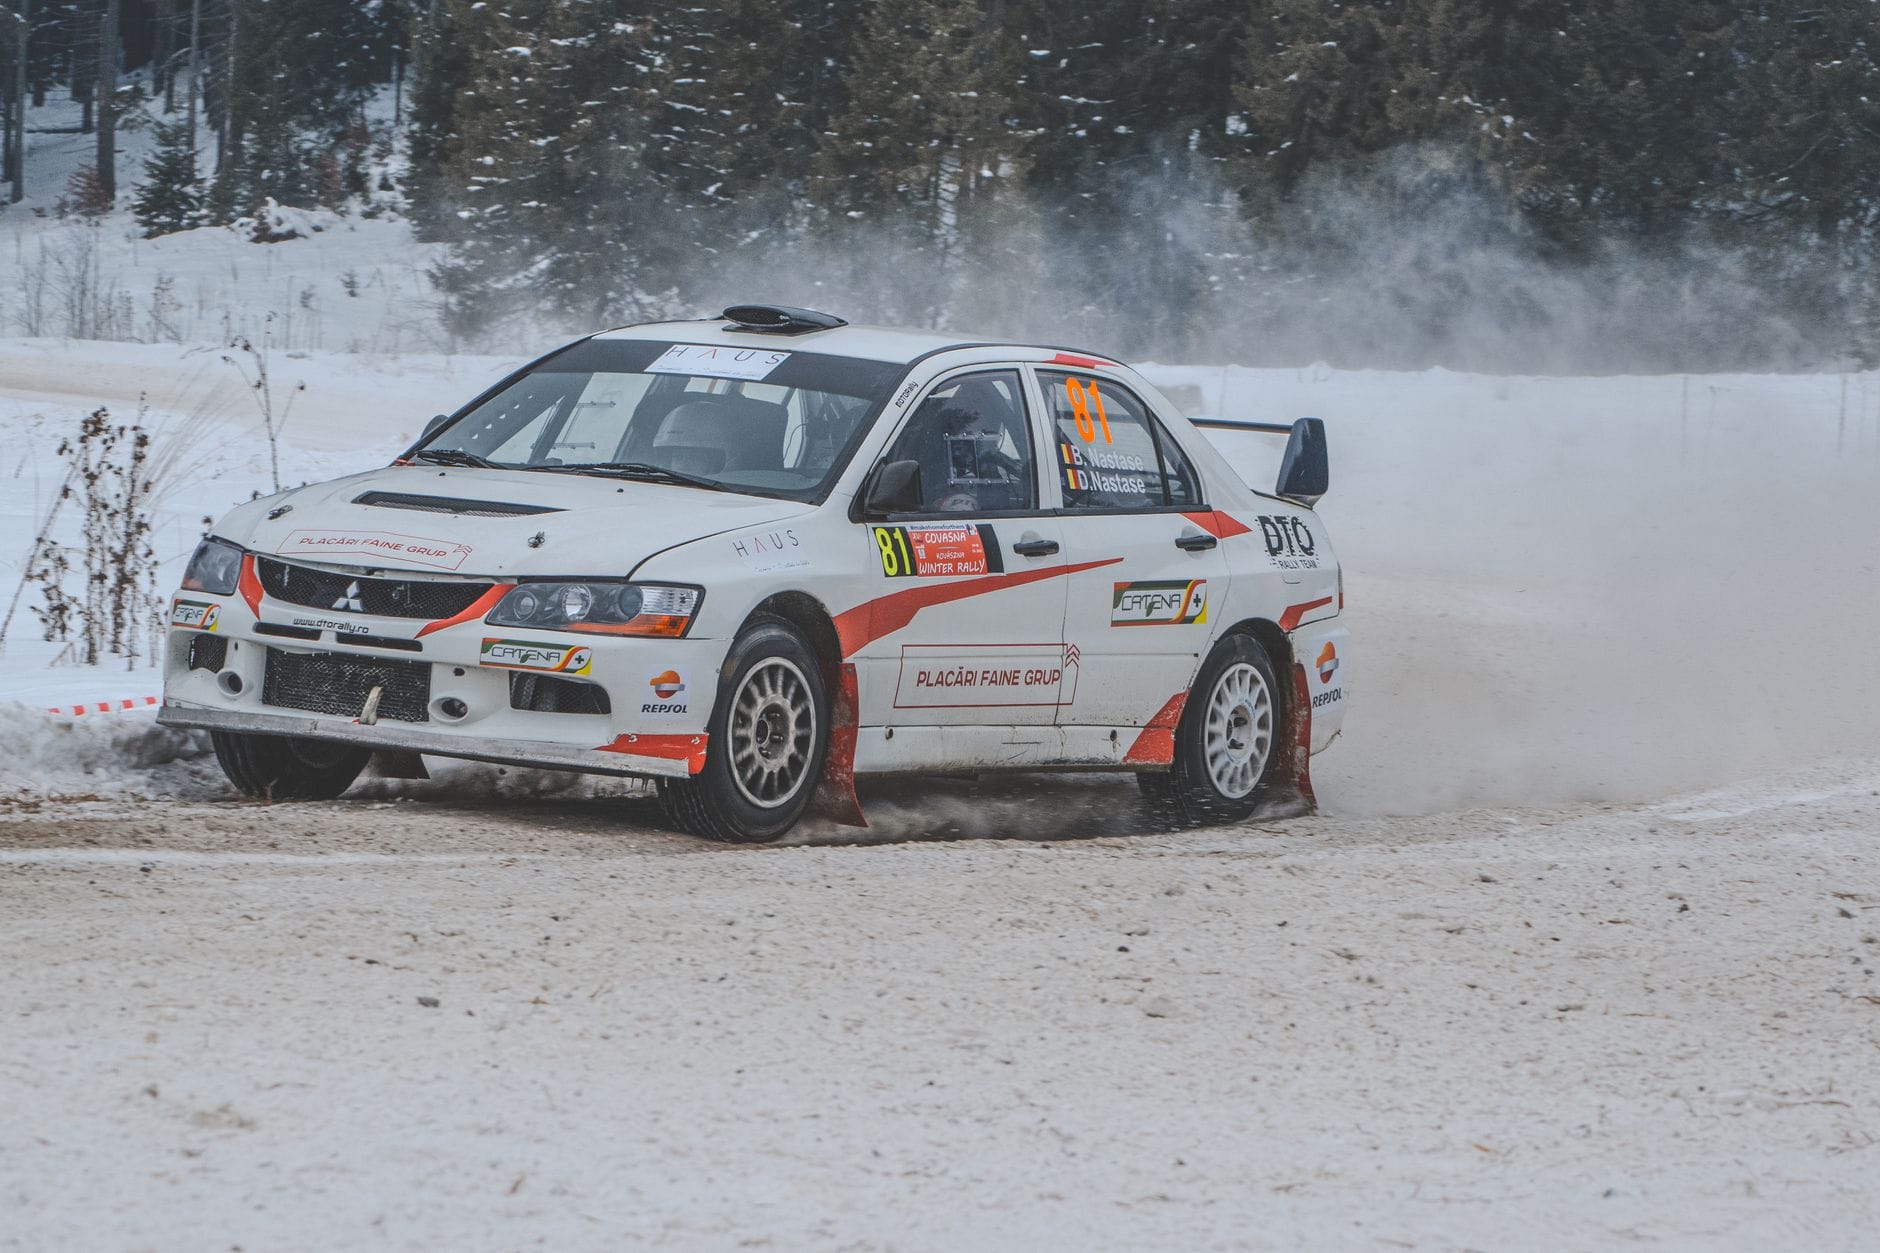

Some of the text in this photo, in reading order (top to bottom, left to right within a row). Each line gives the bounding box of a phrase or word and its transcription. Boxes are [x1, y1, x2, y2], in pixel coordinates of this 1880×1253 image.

[1065, 377, 1113, 445] 81
[1071, 444, 1144, 471] B. Nastase
[924, 531, 967, 544] COVASNA
[1257, 515, 1315, 556] DTO
[361, 538, 404, 551] FAINE
[406, 545, 448, 558] GRUP
[874, 527, 912, 577] 81
[919, 558, 985, 574] WINTER RALLY
[1278, 559, 1318, 569] RALLY TEAM
[1121, 593, 1181, 611] CATENA
[491, 646, 561, 663] CATENA
[916, 666, 1061, 687] PLACĂRI FAINE GRUP
[1312, 688, 1343, 708] REPSOL
[641, 704, 688, 714] REPSOL
